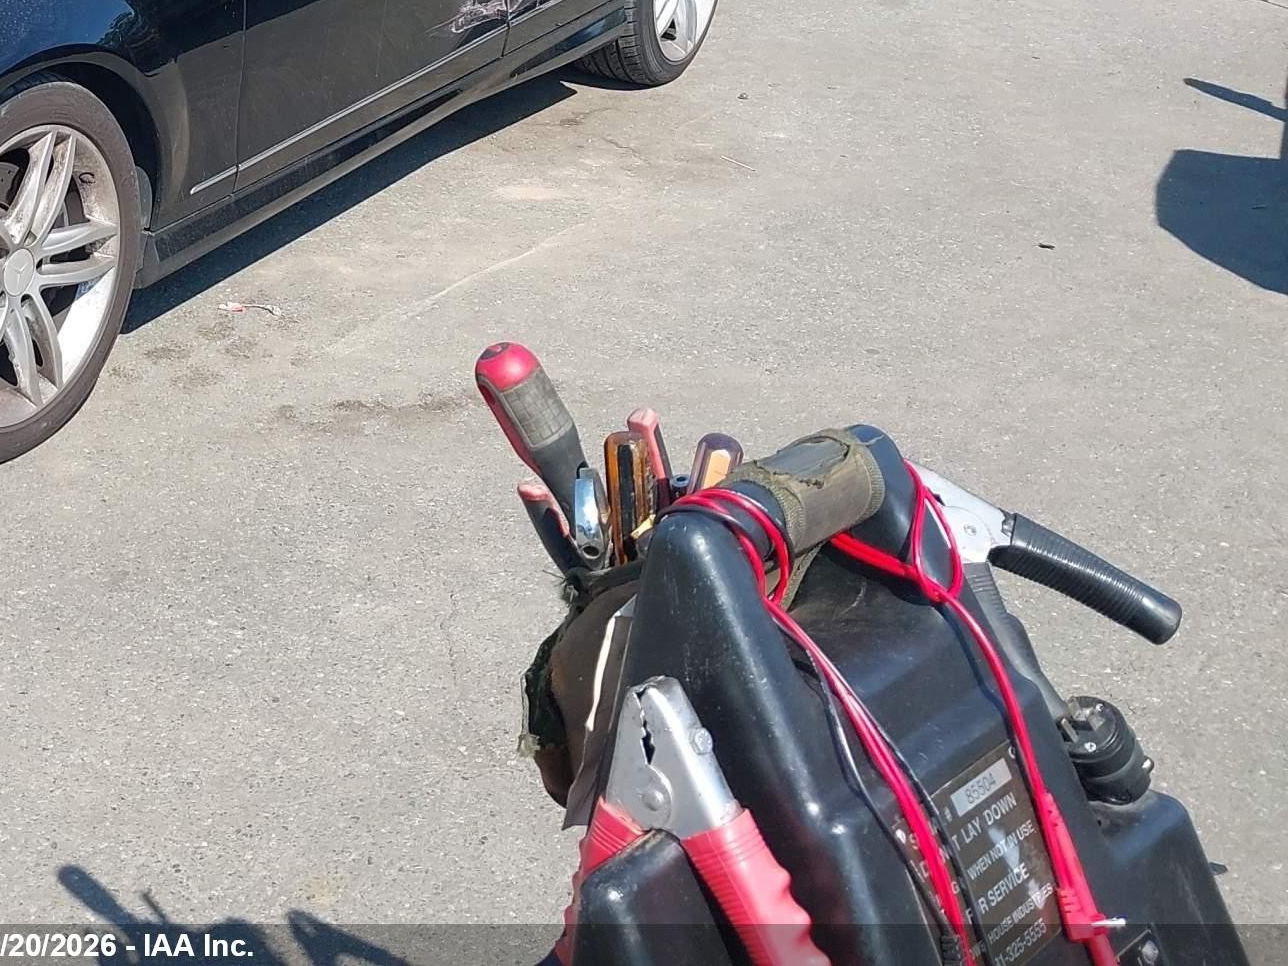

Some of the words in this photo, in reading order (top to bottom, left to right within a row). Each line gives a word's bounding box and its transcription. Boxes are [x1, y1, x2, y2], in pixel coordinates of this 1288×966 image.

[964, 772, 997, 805] 85504
[960, 816, 983, 844] LAY
[983, 792, 1018, 826] DOWN
[967, 852, 993, 881] WHEN
[989, 839, 1009, 863] NOT
[987, 862, 1030, 907] SERVICE
